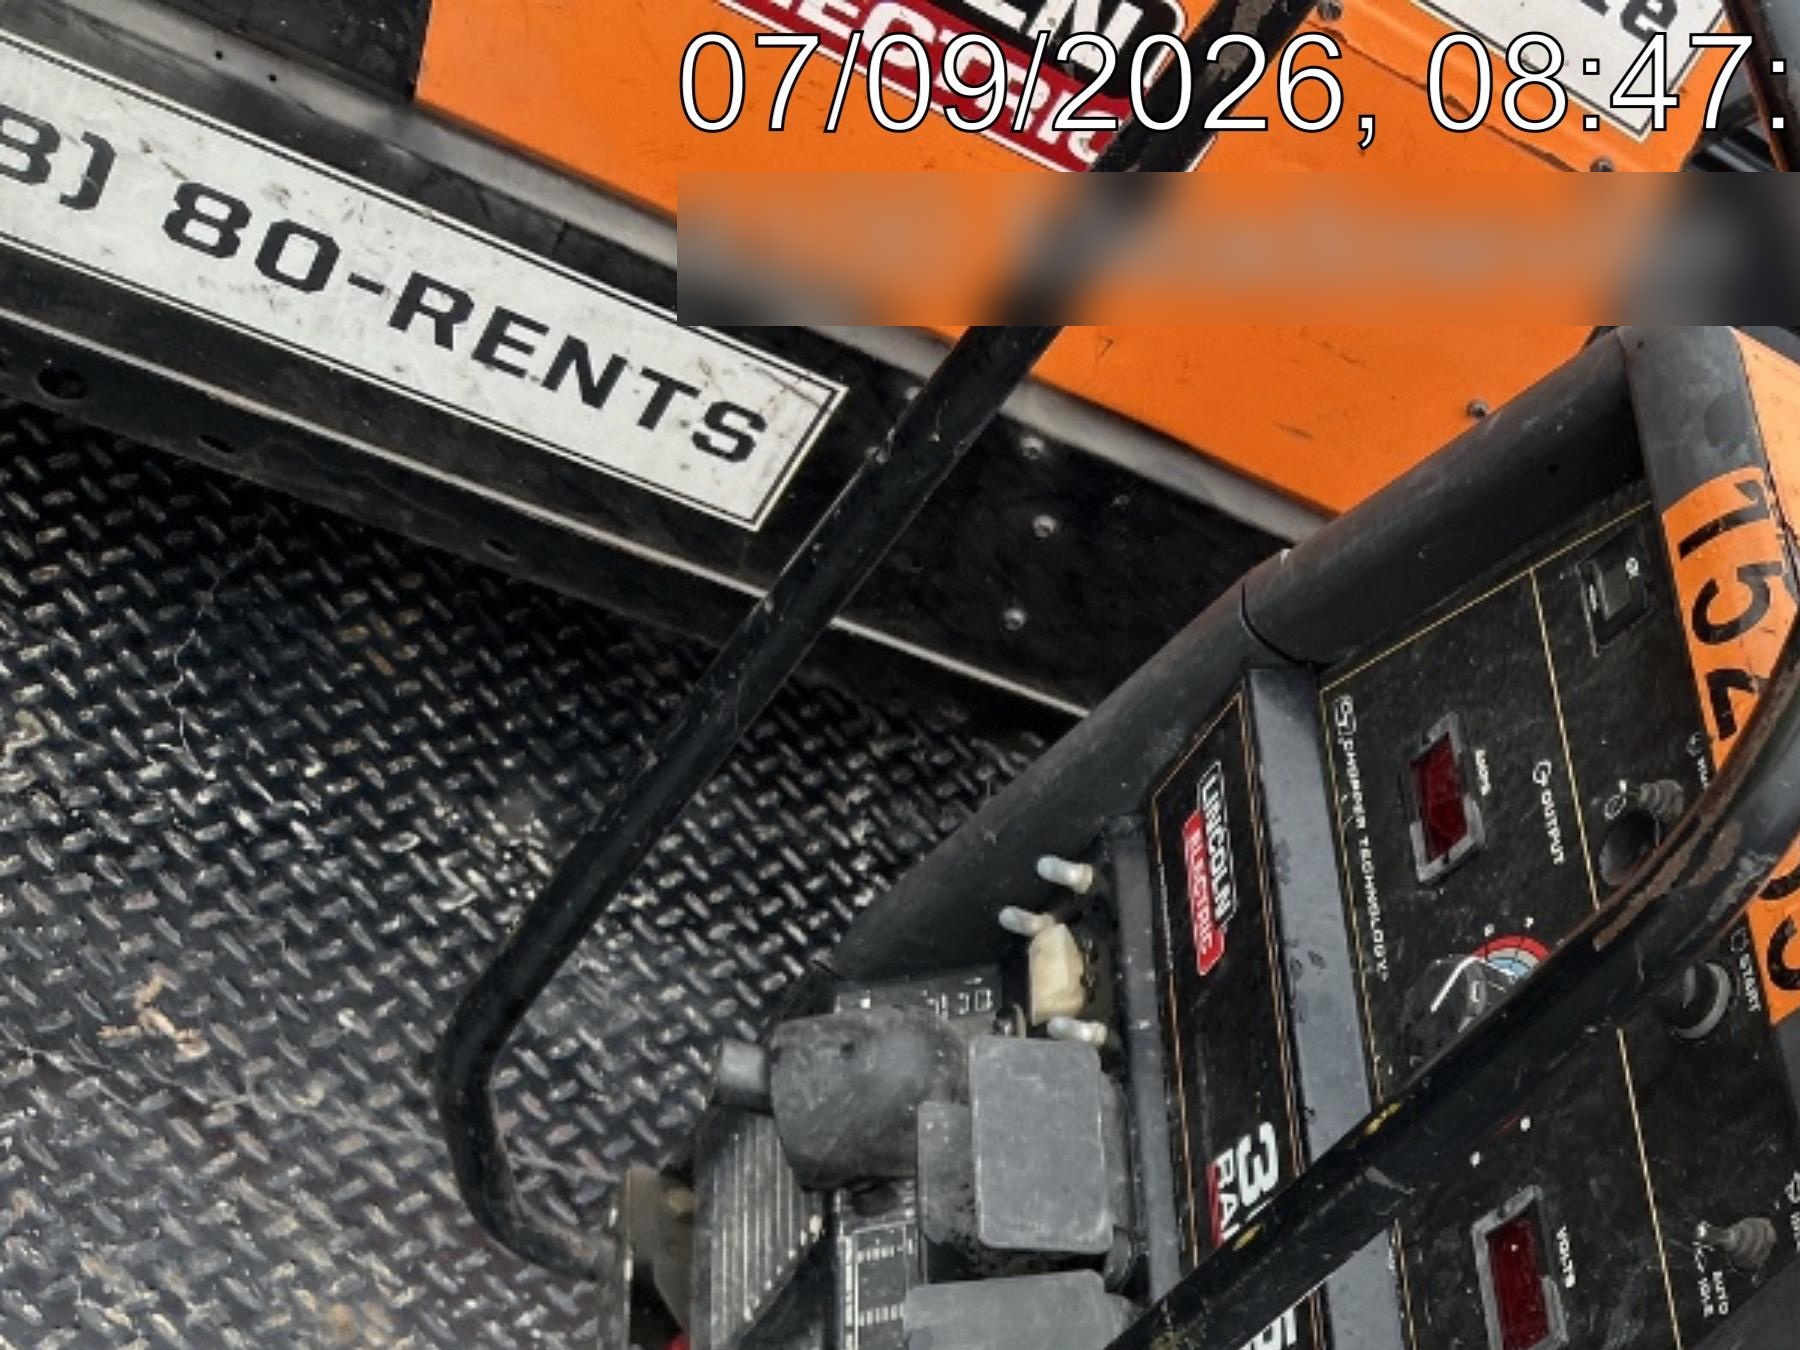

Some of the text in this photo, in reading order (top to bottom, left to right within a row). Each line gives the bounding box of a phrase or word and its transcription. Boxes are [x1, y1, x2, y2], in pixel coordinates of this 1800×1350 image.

[163, 181, 767, 464] 80-RENTS
[1201, 773, 1231, 921] LINCOLN
[1541, 789, 1564, 865] OUTPUT
